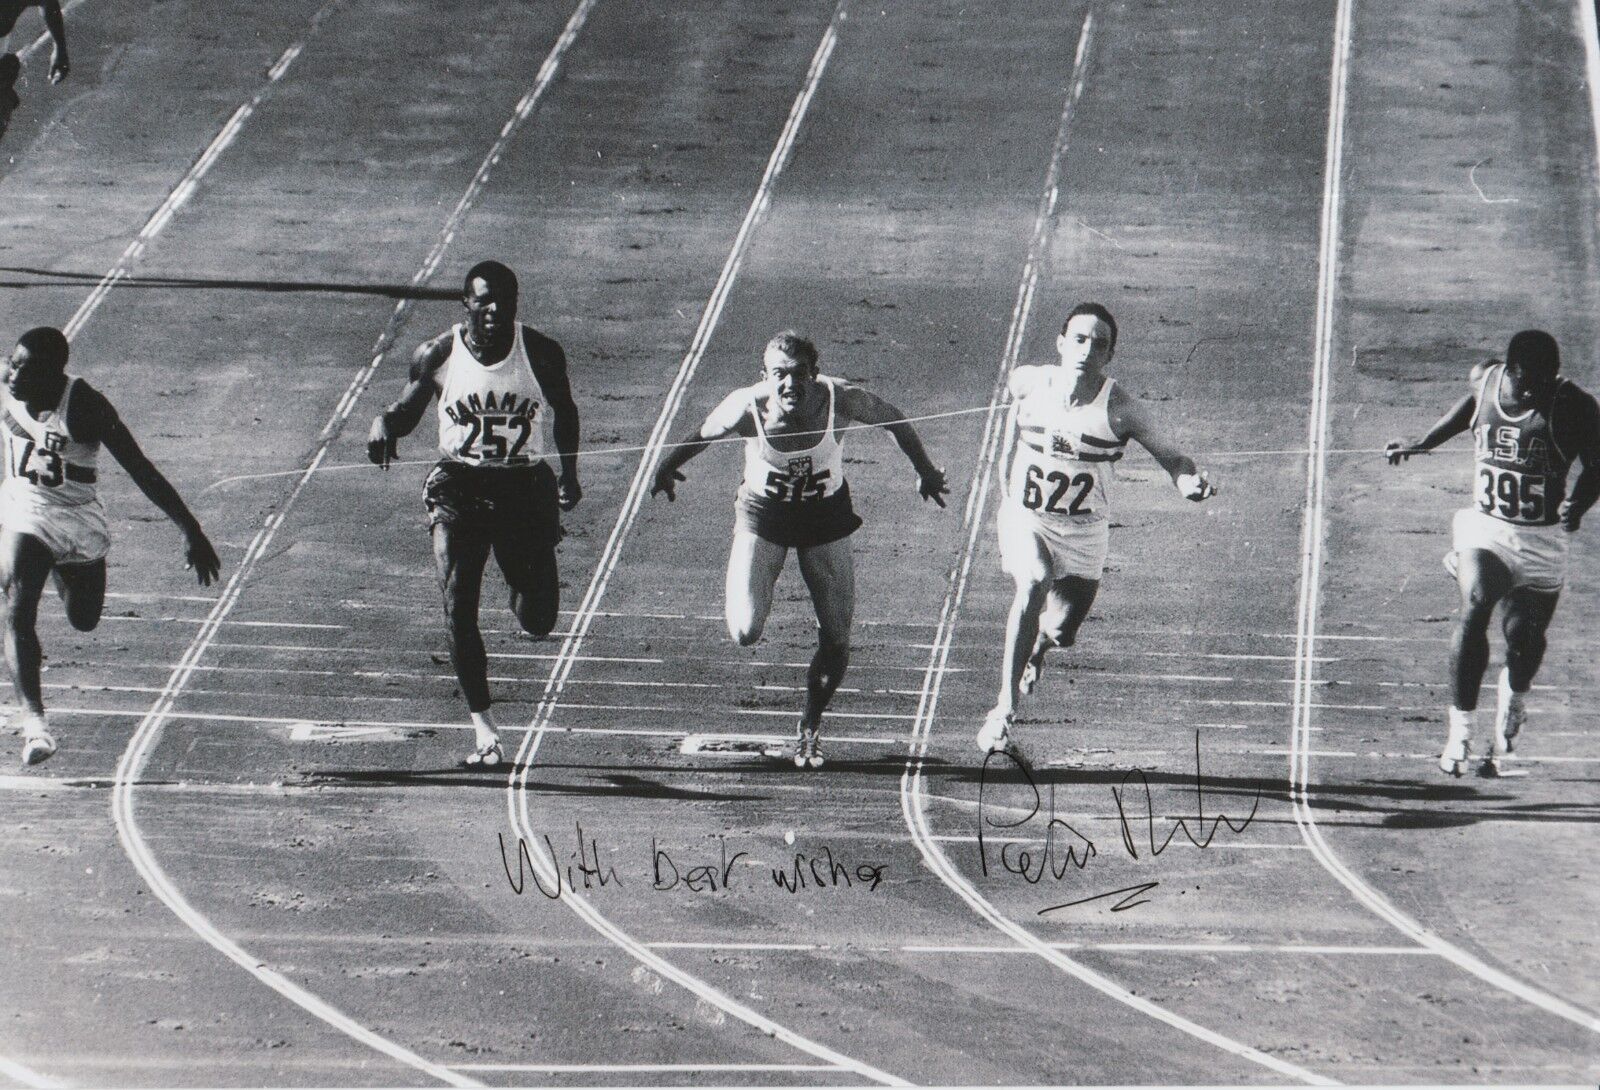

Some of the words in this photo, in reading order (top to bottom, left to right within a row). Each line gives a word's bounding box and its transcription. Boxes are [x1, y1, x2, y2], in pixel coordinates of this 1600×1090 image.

[445, 391, 539, 424] BAHAMAS
[459, 416, 531, 464] 252
[1023, 464, 1094, 516] 622
[1480, 468, 1544, 520] 395
[499, 822, 623, 899] With
